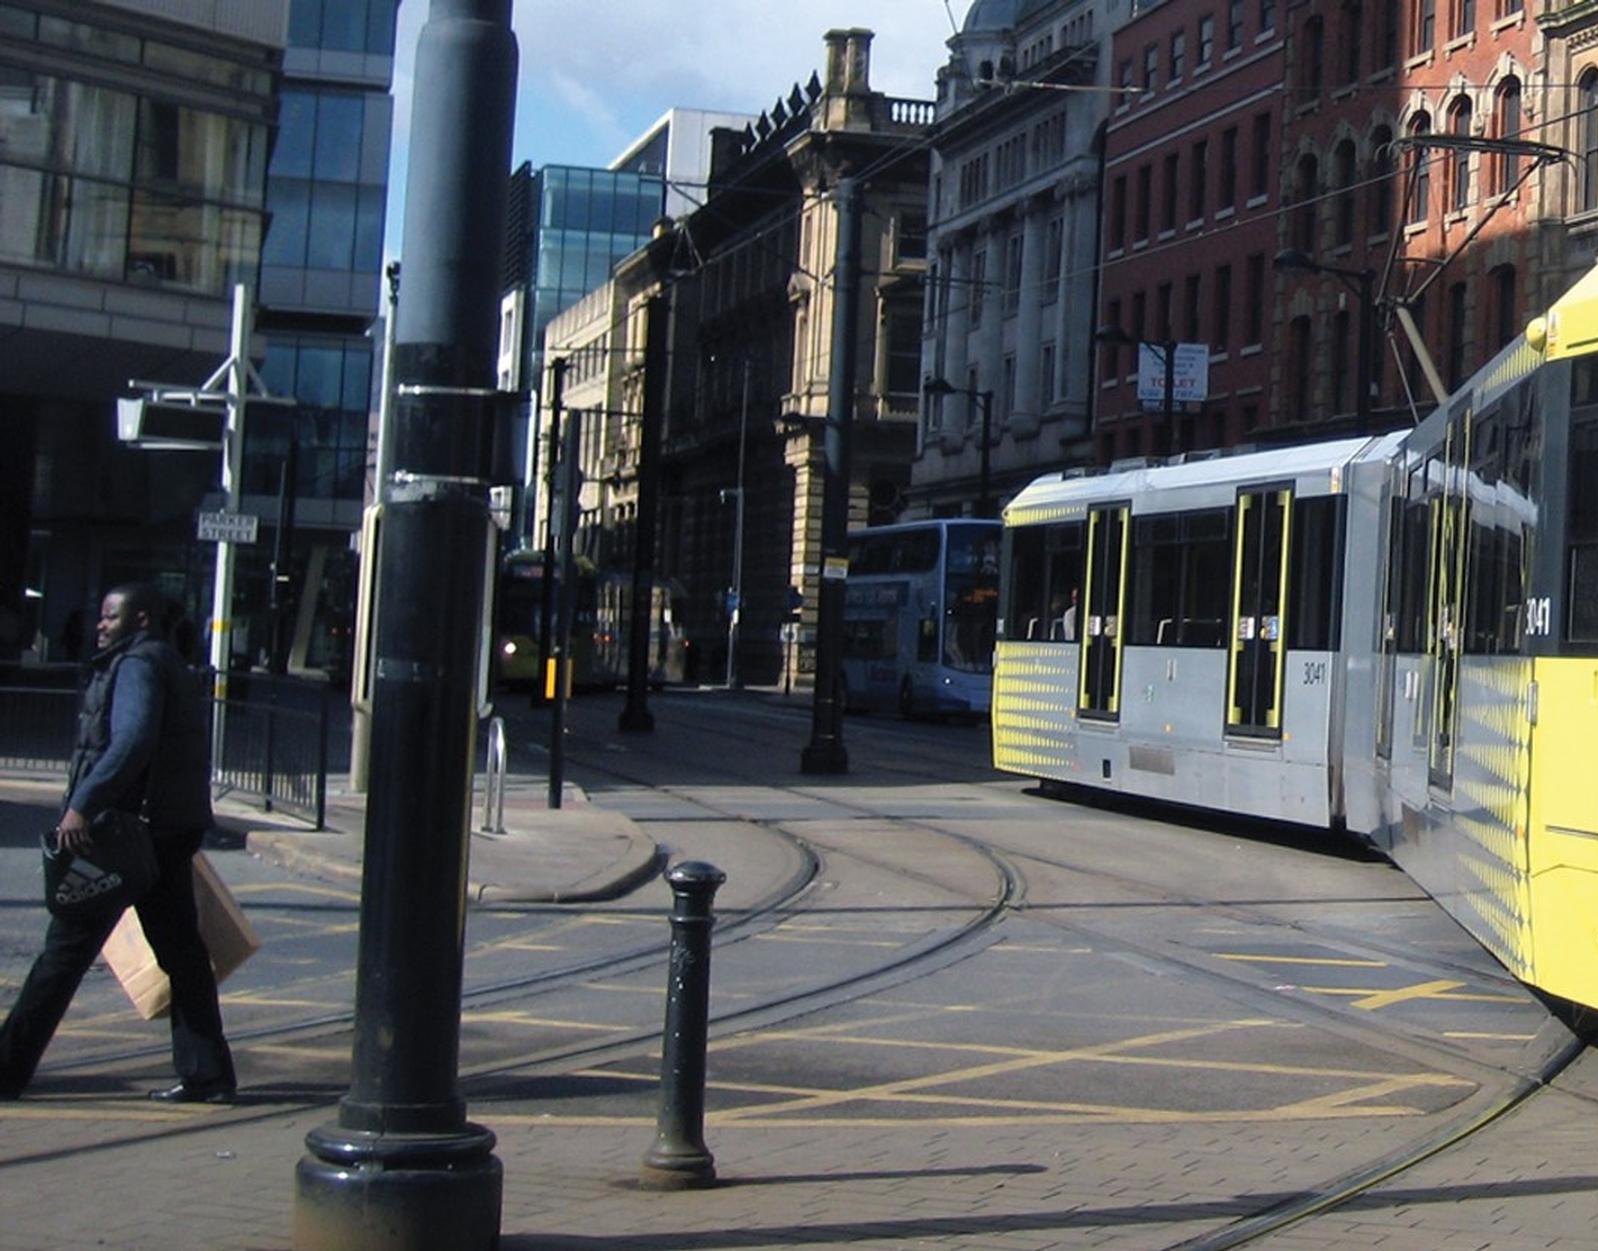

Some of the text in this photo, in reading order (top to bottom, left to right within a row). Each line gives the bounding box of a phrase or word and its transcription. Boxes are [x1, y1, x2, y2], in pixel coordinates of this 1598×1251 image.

[201, 527, 253, 541] STREET
[1525, 597, 1551, 635] 3041
[1303, 662, 1326, 685] 3041
[56, 872, 122, 904] adidas
